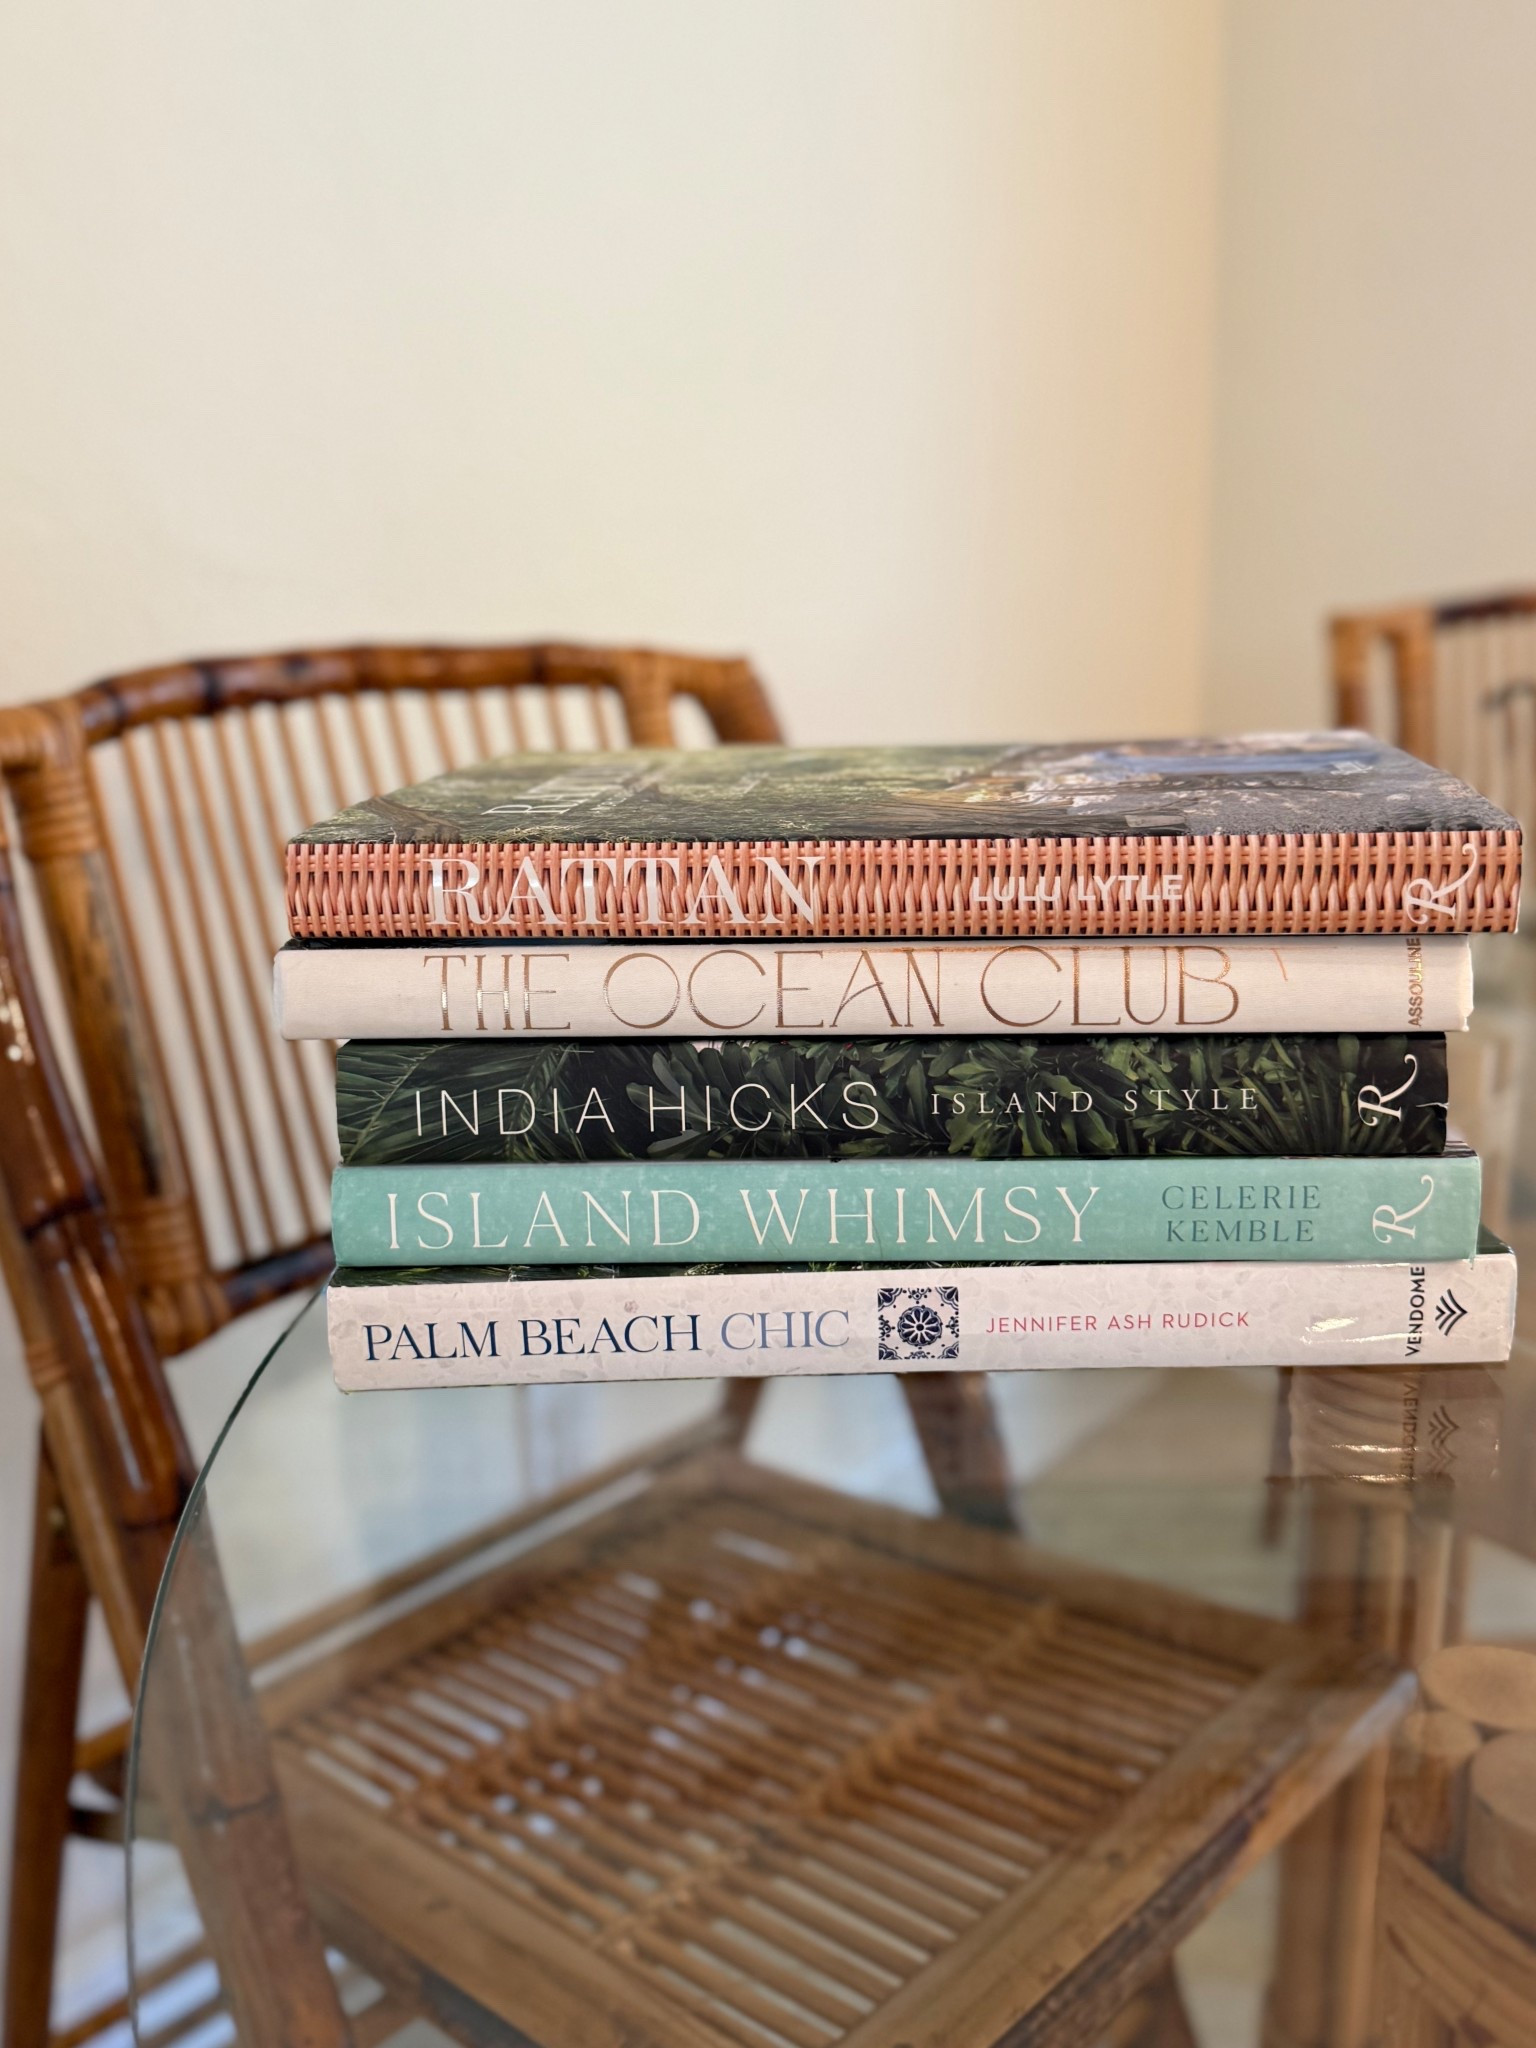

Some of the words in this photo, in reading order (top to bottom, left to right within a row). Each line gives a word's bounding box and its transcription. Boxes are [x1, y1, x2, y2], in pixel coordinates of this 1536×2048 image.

[424, 855, 826, 926] RATTAN
[970, 875, 1062, 903] LULU
[1077, 873, 1184, 901] LYTLE
[423, 952, 571, 1033] THE
[603, 948, 945, 1029] OCEAN
[980, 945, 1239, 1027] CLUB
[1407, 936, 1422, 1028] ASSOULINE
[414, 1086, 615, 1136] INDIA
[648, 1081, 880, 1132] HICKS
[930, 1091, 1094, 1116] ISLAND
[1124, 1087, 1260, 1113] STYLE
[387, 1189, 700, 1250] ISLAND
[738, 1185, 1101, 1246] WHIMSY
[1161, 1184, 1323, 1211] CELERIE
[1165, 1218, 1316, 1244] KEMBLE
[362, 1320, 500, 1362] PALM
[519, 1314, 702, 1356] BEACH
[720, 1309, 850, 1351] CHIC
[985, 1316, 1098, 1334] JENNIFER
[1107, 1314, 1154, 1331] ASH
[1162, 1310, 1250, 1329] RUDICK
[1405, 1265, 1427, 1358] VENDOME
